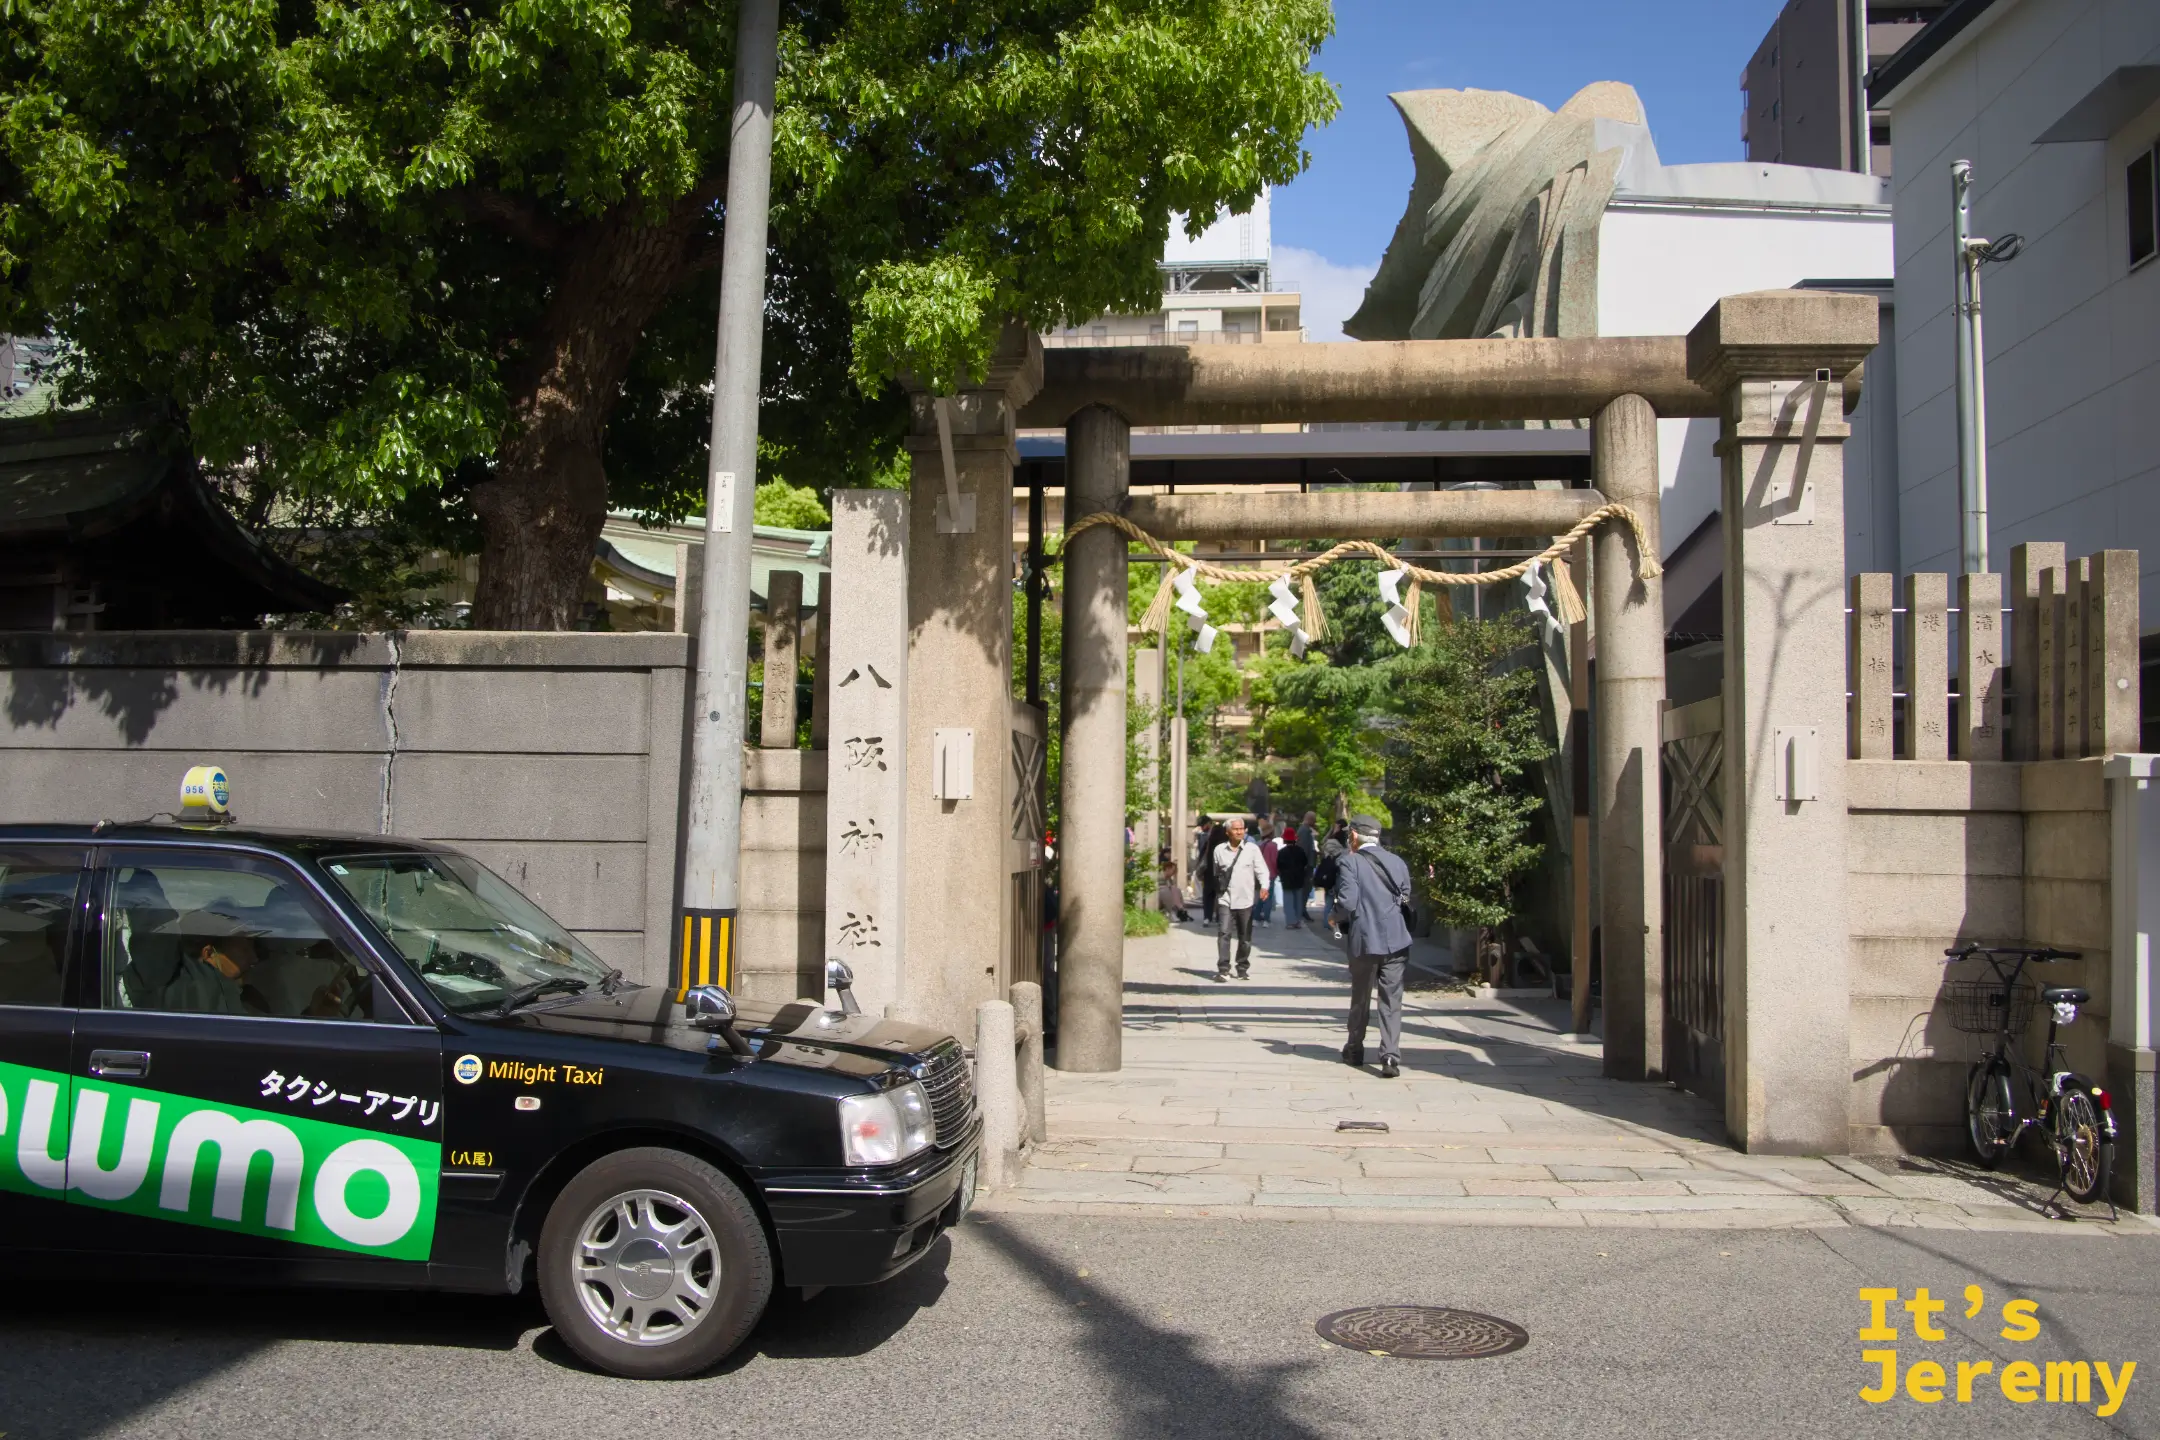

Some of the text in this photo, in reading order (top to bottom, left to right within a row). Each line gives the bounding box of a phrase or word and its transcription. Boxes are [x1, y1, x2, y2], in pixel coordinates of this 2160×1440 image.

[185, 785, 204, 794] 958
[836, 663, 892, 950] 八阪神社
[488, 1060, 604, 1085] Milight Taxi
[260, 1069, 441, 1127] タクシーアプリ
[0, 1076, 421, 1247] wmo
[451, 1150, 493, 1167] (八尾)
